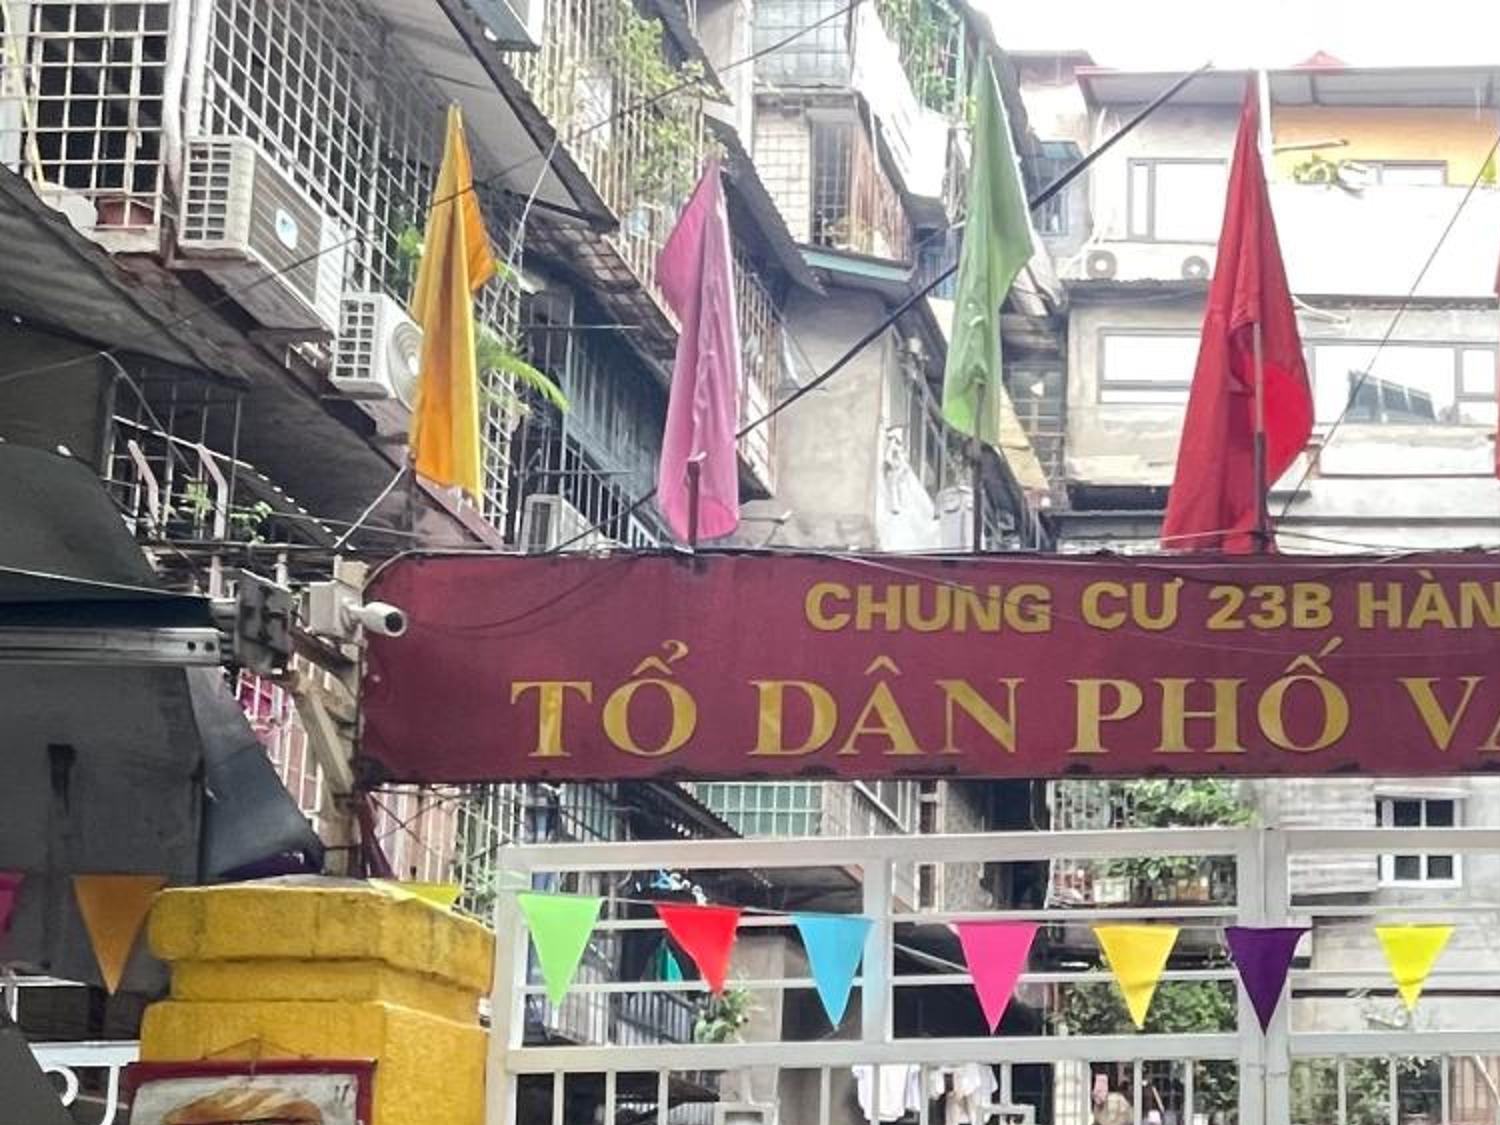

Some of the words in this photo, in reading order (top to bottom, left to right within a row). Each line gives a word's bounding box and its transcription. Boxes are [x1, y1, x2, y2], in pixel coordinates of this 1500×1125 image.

[805, 580, 1051, 633] CHUNG
[1081, 576, 1185, 631] CƯ
[1206, 583, 1332, 630] 23B
[510, 639, 699, 758] TỔ
[747, 655, 1025, 757] DÂN
[1065, 636, 1351, 754] PHỐ
